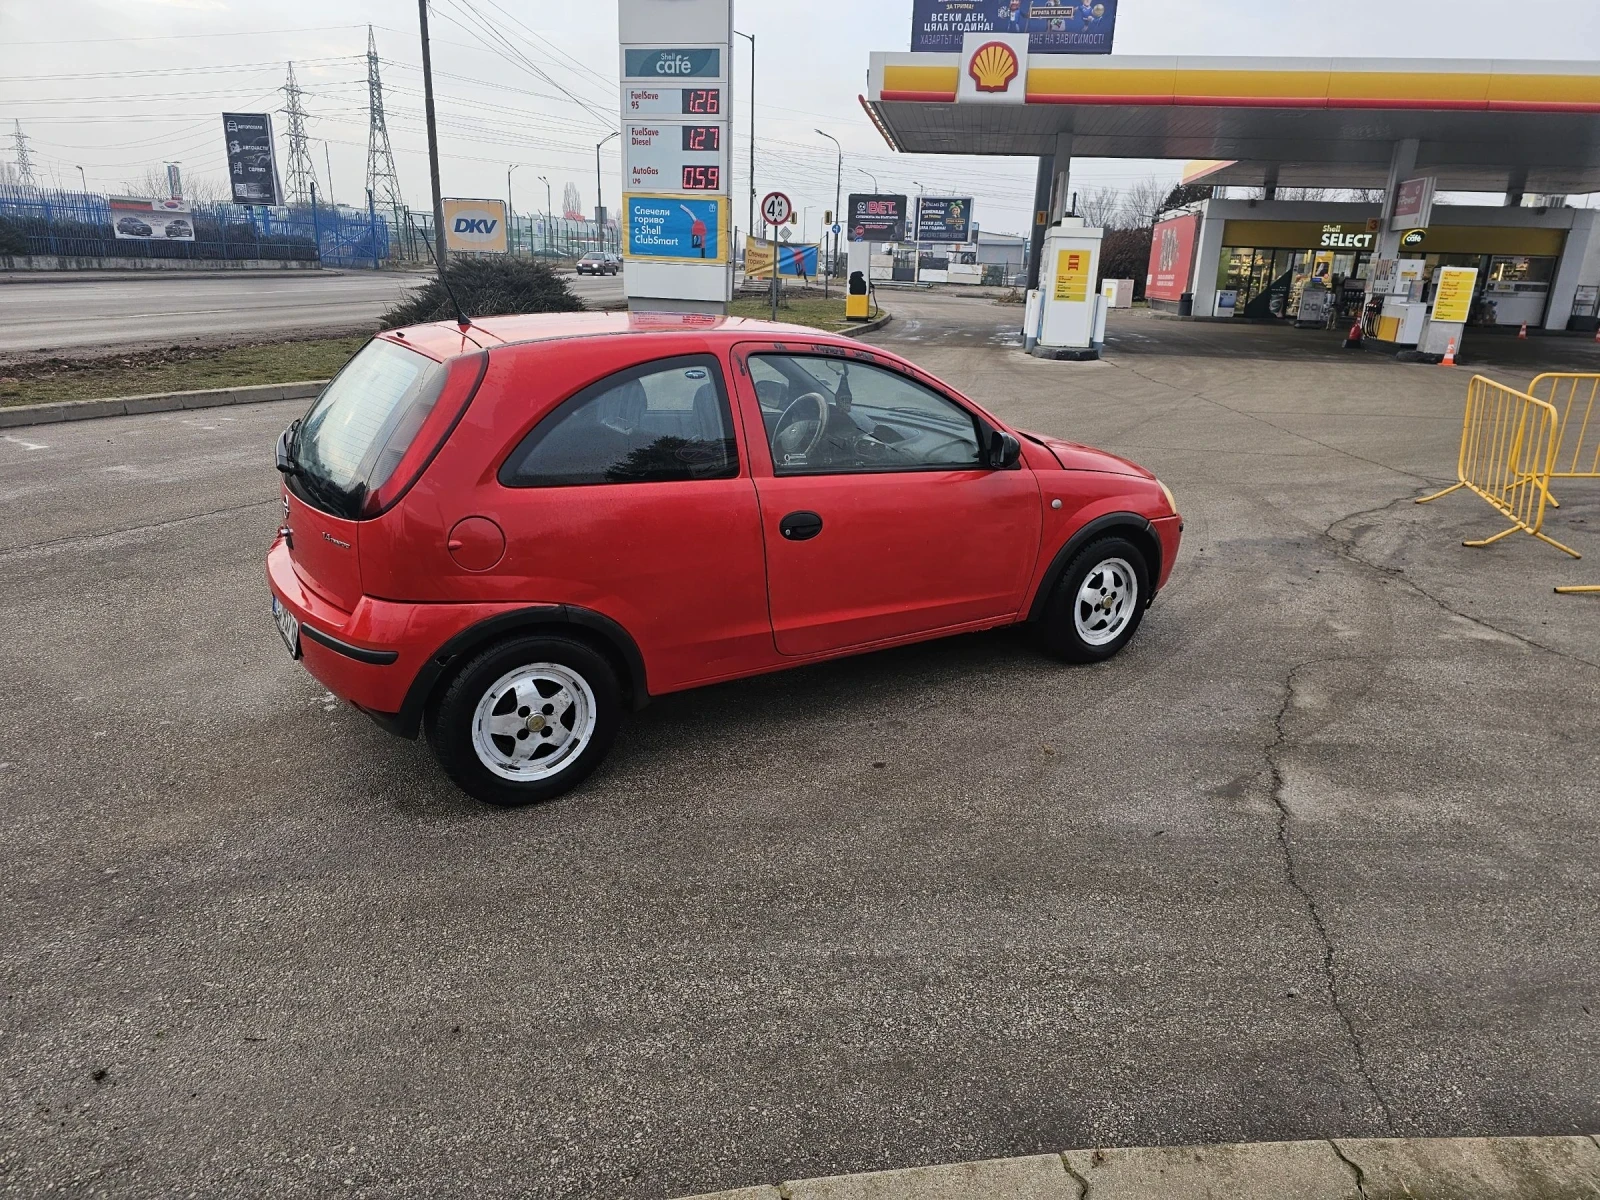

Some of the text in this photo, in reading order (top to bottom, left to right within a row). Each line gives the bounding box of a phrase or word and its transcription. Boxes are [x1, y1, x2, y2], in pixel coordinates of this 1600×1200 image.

[931, 13, 987, 22] ВСЕКИ ДЕН,
[924, 22, 994, 32] ЦЯЛА ГОДИНА!
[920, 33, 1104, 44] ХАЗАРТЪТ НО АНЕ НА ЗАВИСИМОСТ!
[656, 55, 691, 74] café
[631, 91, 658, 100] FuelSave
[631, 101, 639, 109] 95
[632, 127, 659, 136] FuelSave
[632, 137, 651, 145] Diesel
[633, 166, 658, 175] AutoGas
[634, 206, 670, 216] Спечели
[634, 216, 664, 225] гориво
[1370, 220, 1377, 230] 3
[454, 218, 498, 234] DKV
[641, 226, 661, 235] Shell
[1322, 224, 1341, 232] Shell
[634, 236, 679, 245] ClubSmart
[1321, 234, 1372, 247] SELECT
[748, 250, 768, 258] Спечели
